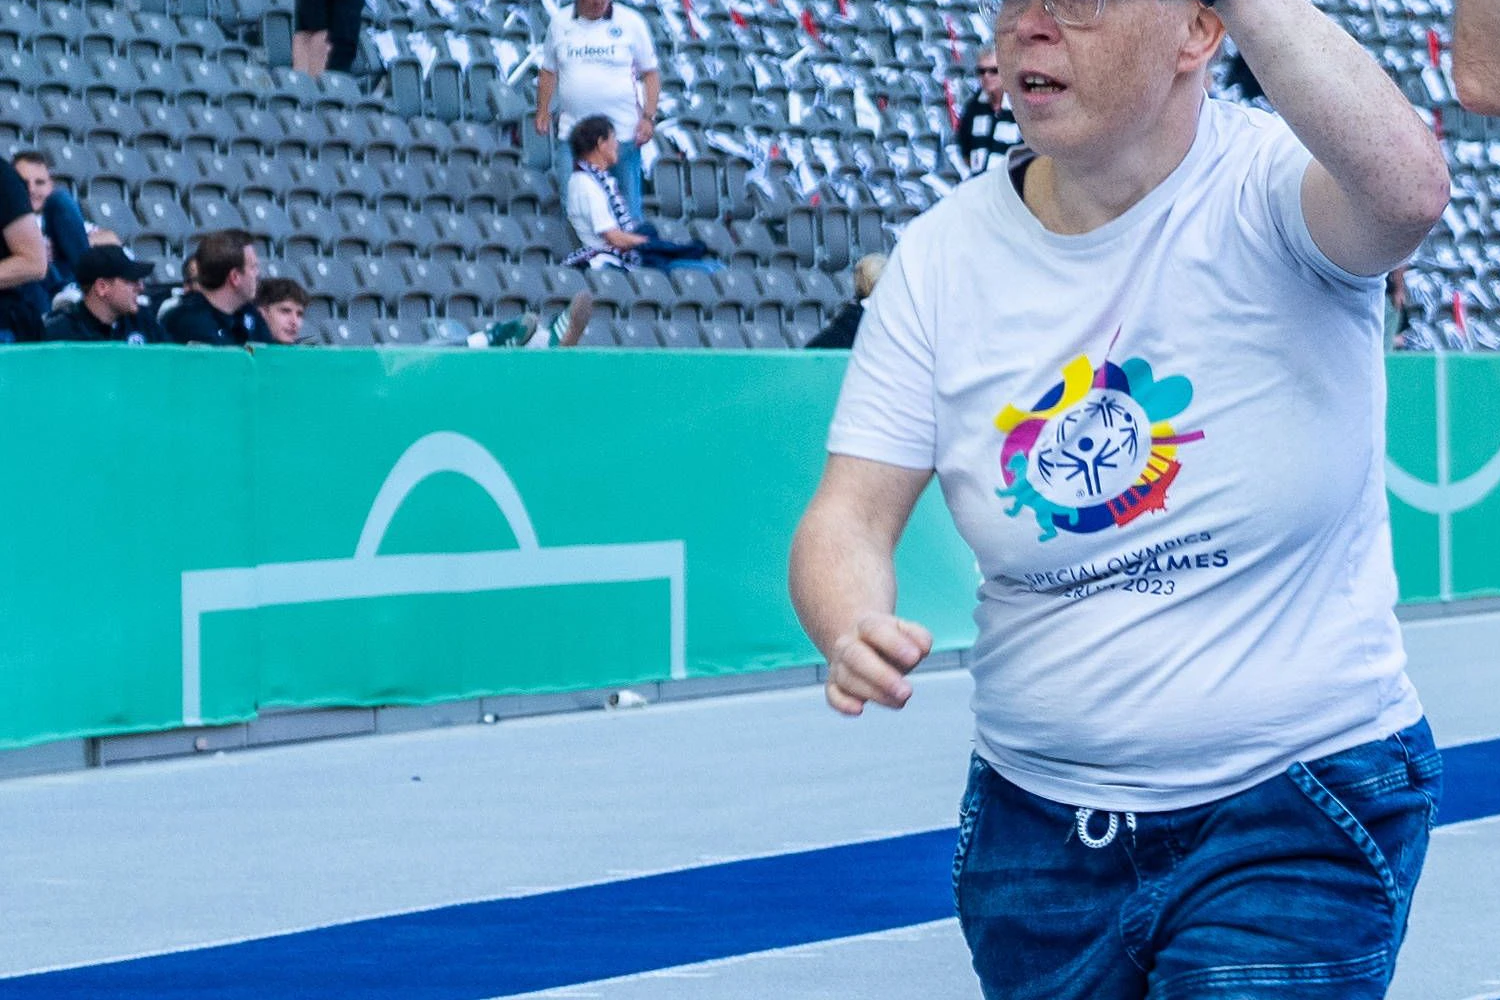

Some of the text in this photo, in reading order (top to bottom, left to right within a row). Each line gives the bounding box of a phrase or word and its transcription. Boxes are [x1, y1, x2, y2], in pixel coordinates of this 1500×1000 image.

[1122, 549, 1230, 576] GAMES
[1024, 563, 1098, 587] SPECIAL
[1122, 577, 1176, 596] 2023
